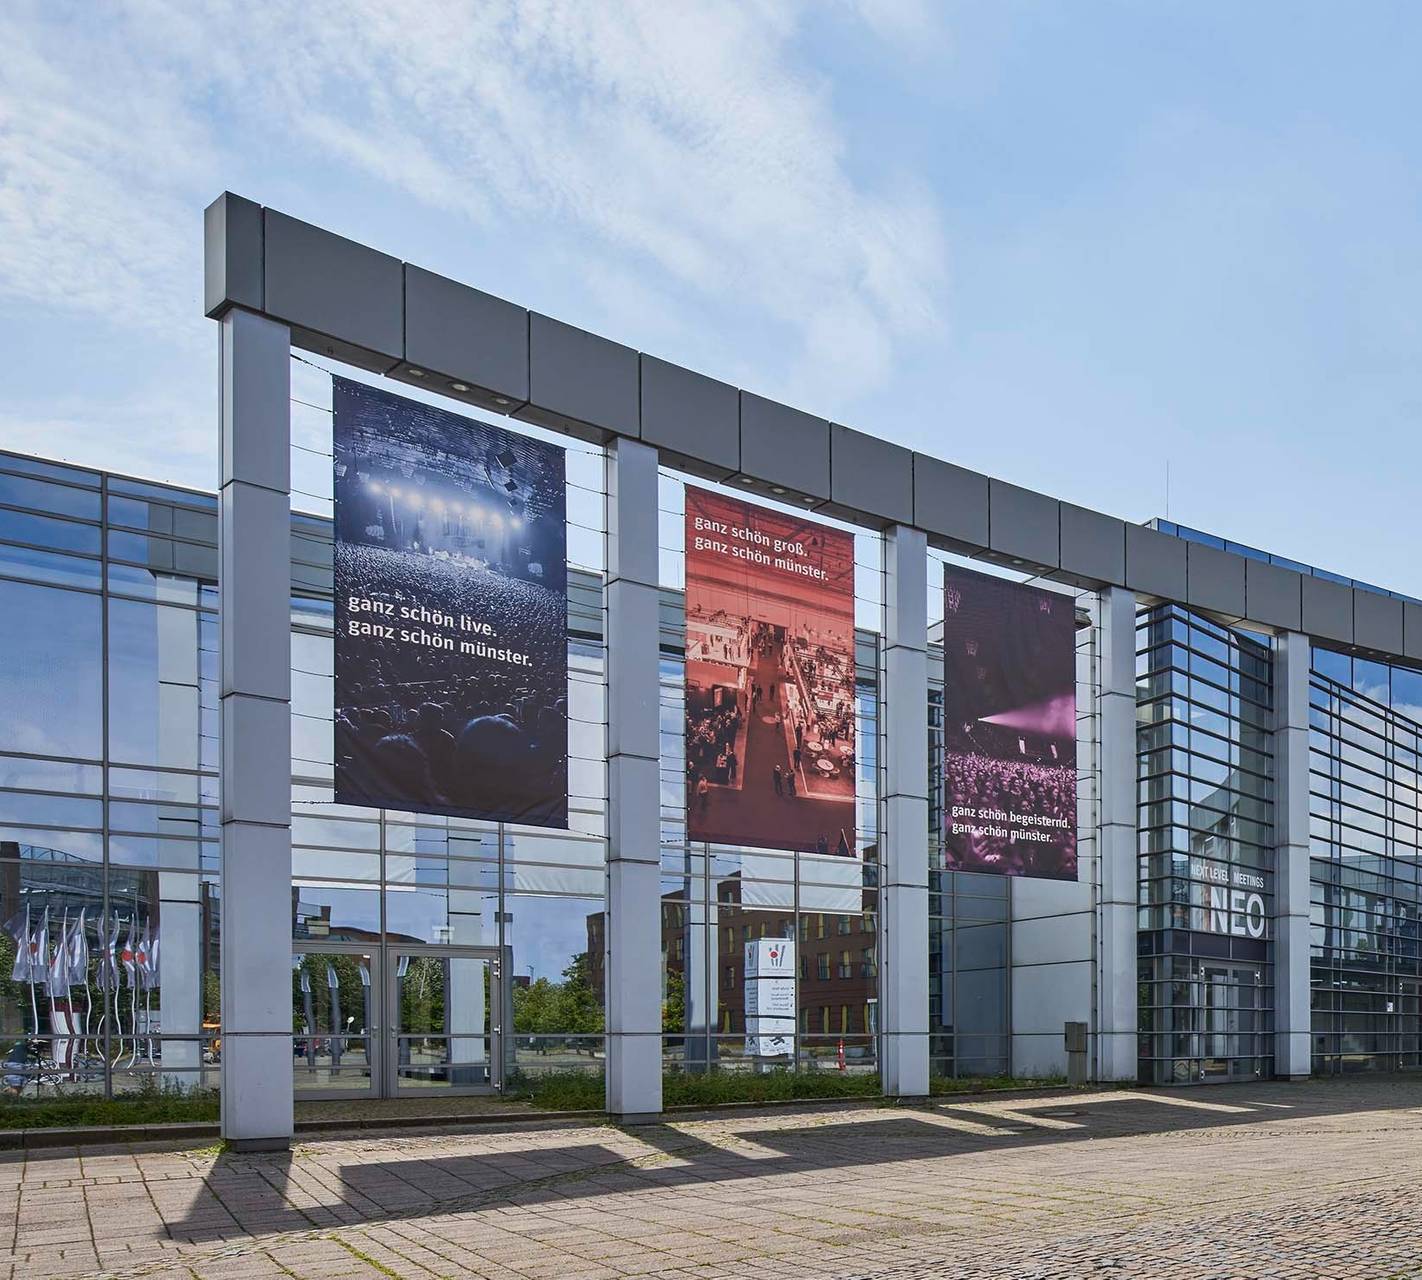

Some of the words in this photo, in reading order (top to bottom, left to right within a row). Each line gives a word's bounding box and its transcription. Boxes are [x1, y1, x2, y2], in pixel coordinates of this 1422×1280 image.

[695, 517, 727, 534] ganz
[732, 528, 769, 546] schön
[774, 539, 807, 556] groß.
[695, 536, 728, 553] ganz
[732, 546, 770, 565] schön
[775, 558, 828, 580] münster.
[348, 596, 394, 615] ganz
[401, 606, 453, 628] schön
[461, 615, 497, 637] live.
[348, 621, 394, 639] ganz
[401, 630, 453, 650] schön
[461, 640, 533, 667] münster.
[952, 806, 976, 817] ganz
[979, 808, 1007, 820] schön
[1010, 811, 1070, 828] begeisternd.
[952, 823, 975, 834] ganz
[979, 825, 1007, 837] schön
[1011, 829, 1052, 842] münster.
[1191, 864, 1208, 879] NEXT
[1210, 867, 1229, 881] LEVEL
[1234, 872, 1263, 888] MEETINGS
[1211, 887, 1264, 937] NEO
